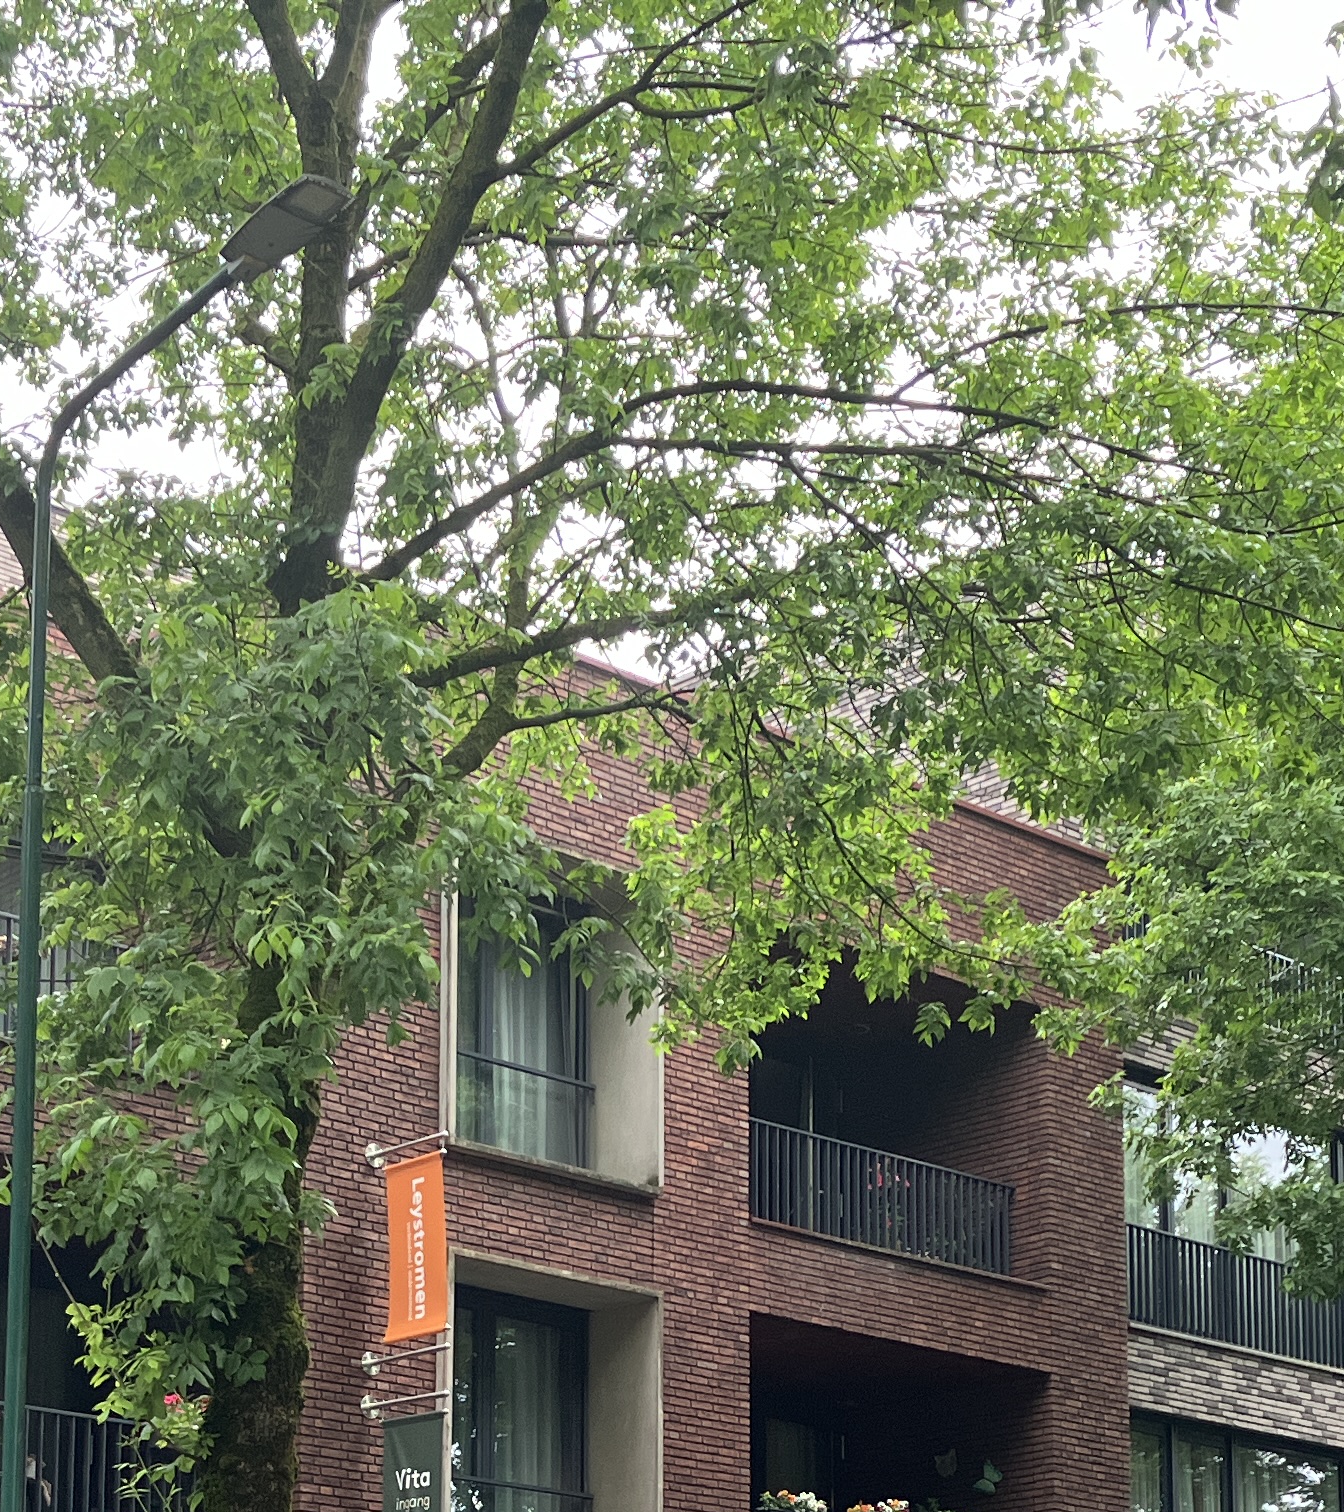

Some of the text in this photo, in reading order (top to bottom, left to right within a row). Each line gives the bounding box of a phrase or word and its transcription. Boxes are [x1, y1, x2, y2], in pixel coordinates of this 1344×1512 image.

[409, 1176, 426, 1320] Leystromen
[395, 1467, 431, 1491] Vita
[395, 1495, 431, 1512] ingang
